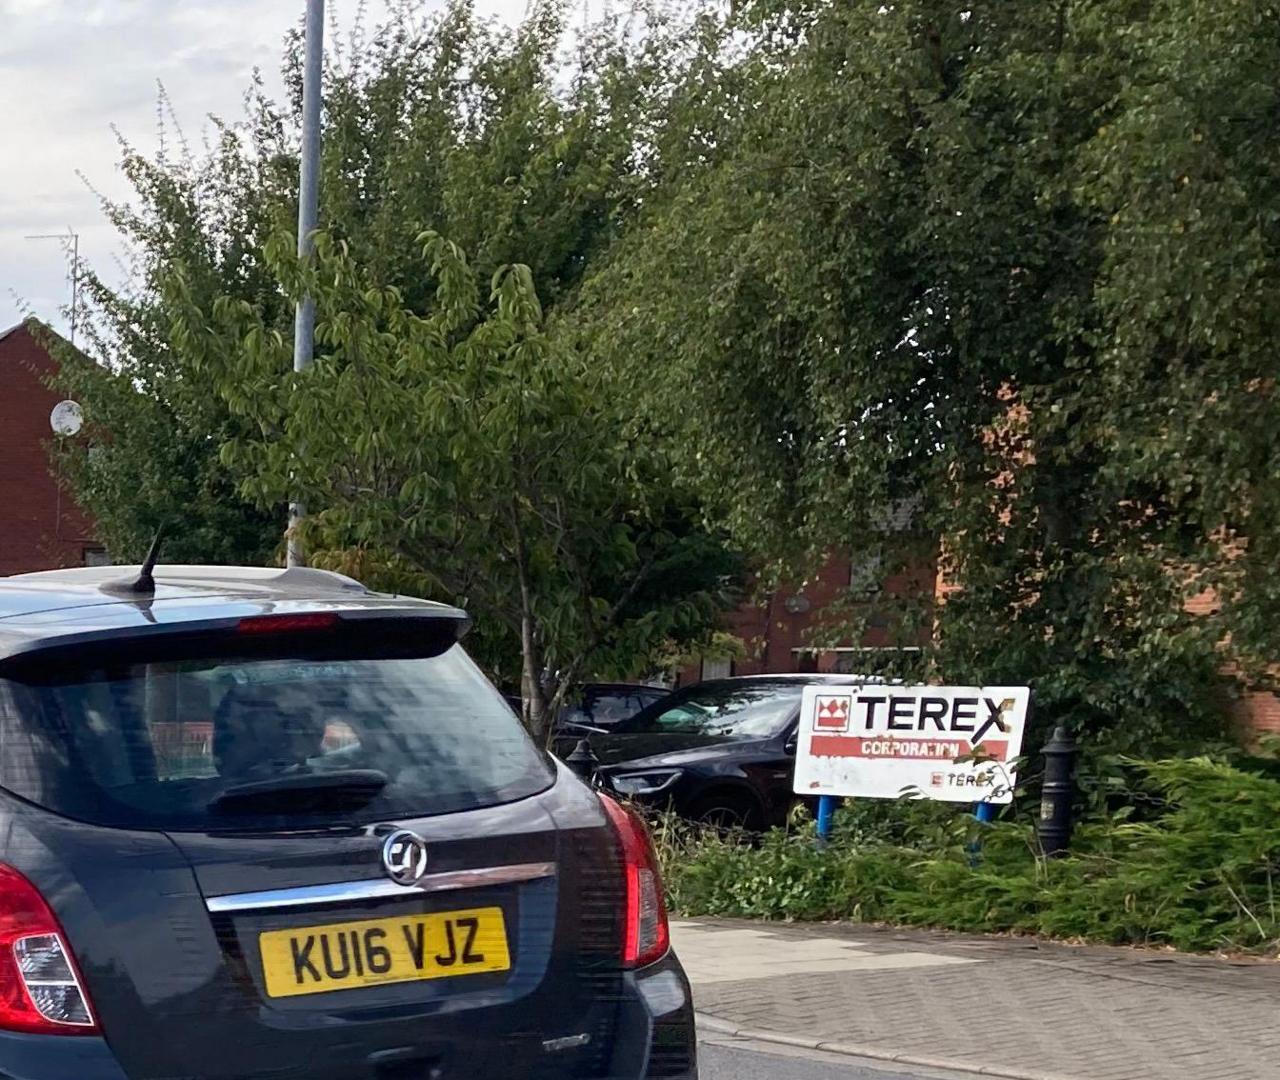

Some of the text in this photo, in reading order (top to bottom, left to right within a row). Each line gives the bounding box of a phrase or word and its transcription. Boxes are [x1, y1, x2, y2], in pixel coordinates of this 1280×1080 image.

[857, 695, 1016, 745] TEREX
[290, 917, 485, 984] KU16 VJZ
